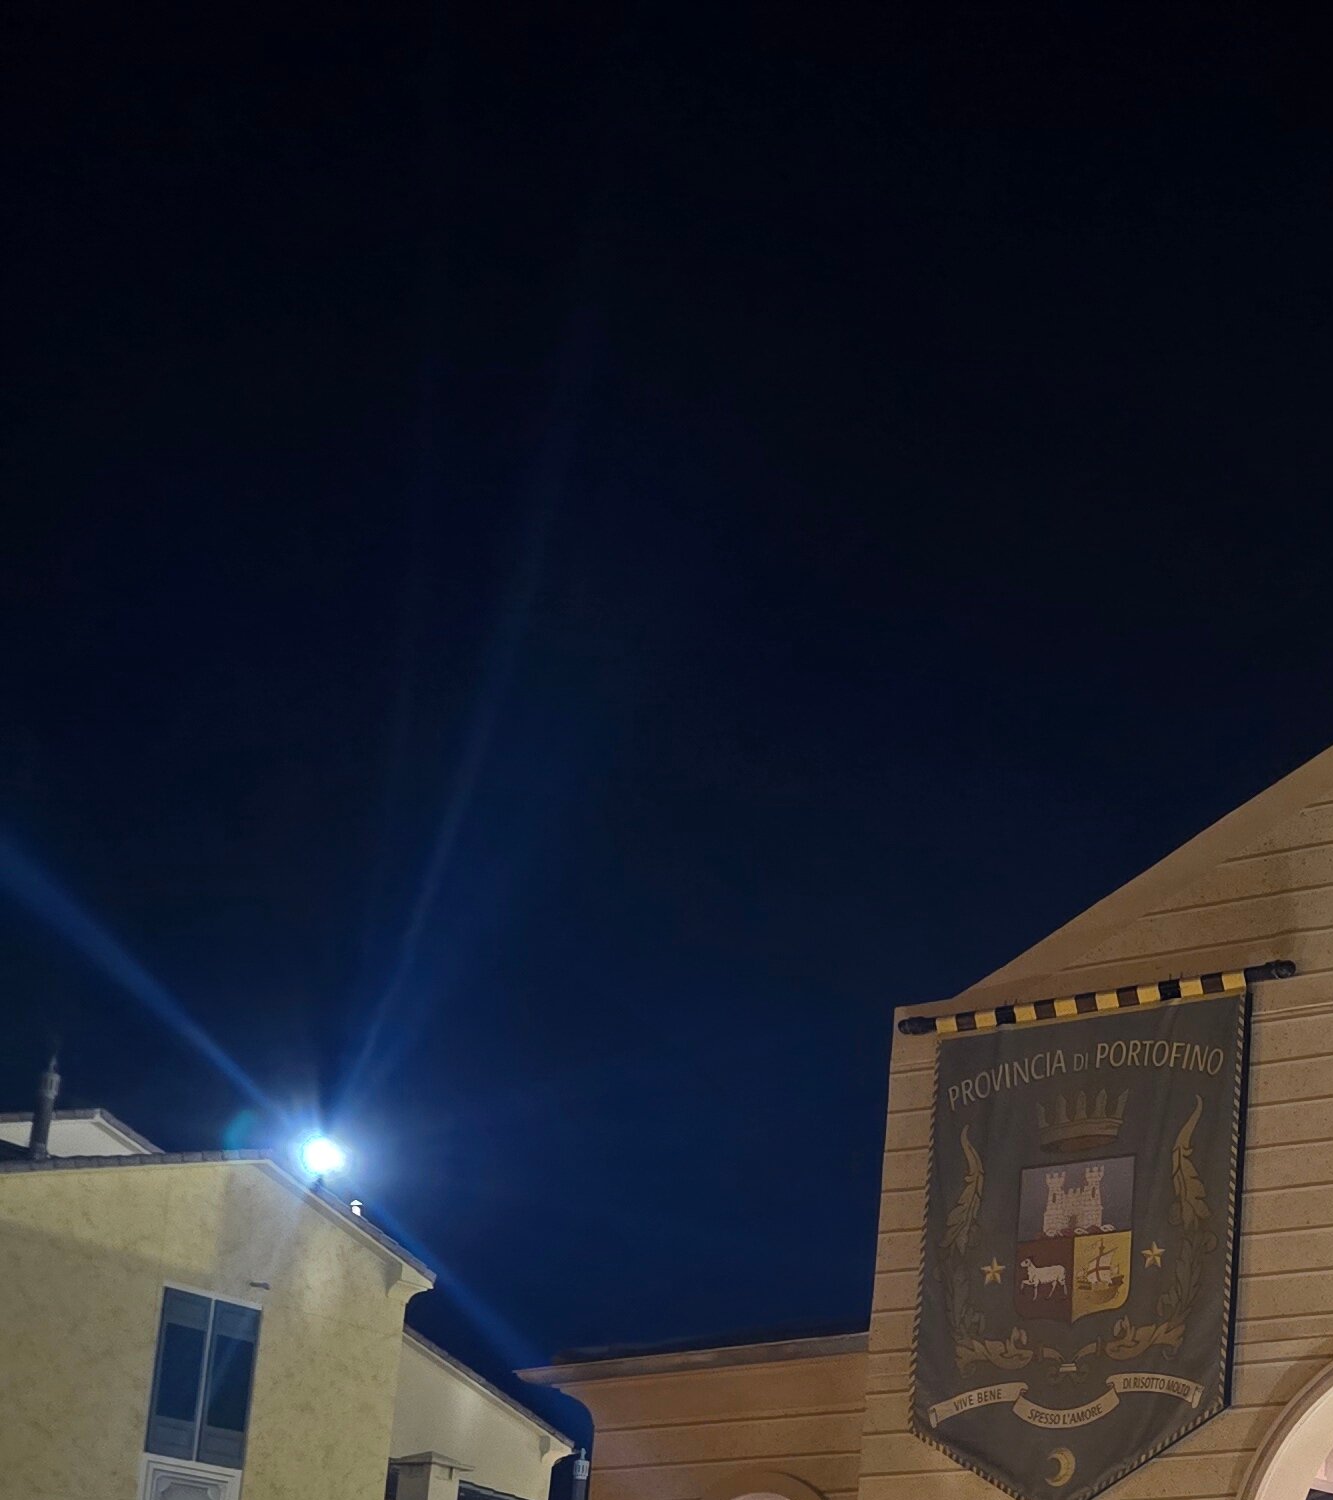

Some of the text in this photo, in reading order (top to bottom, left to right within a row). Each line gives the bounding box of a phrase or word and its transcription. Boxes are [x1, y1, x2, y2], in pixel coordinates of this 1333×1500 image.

[947, 1039, 1225, 1112] PROVINCIA DI PORTOFINO
[1122, 1375, 1190, 1396] DI RISOTTO MOLTO
[953, 1387, 1003, 1413] VIVE BENE
[1027, 1402, 1104, 1426] SPESSO L'AMORE
